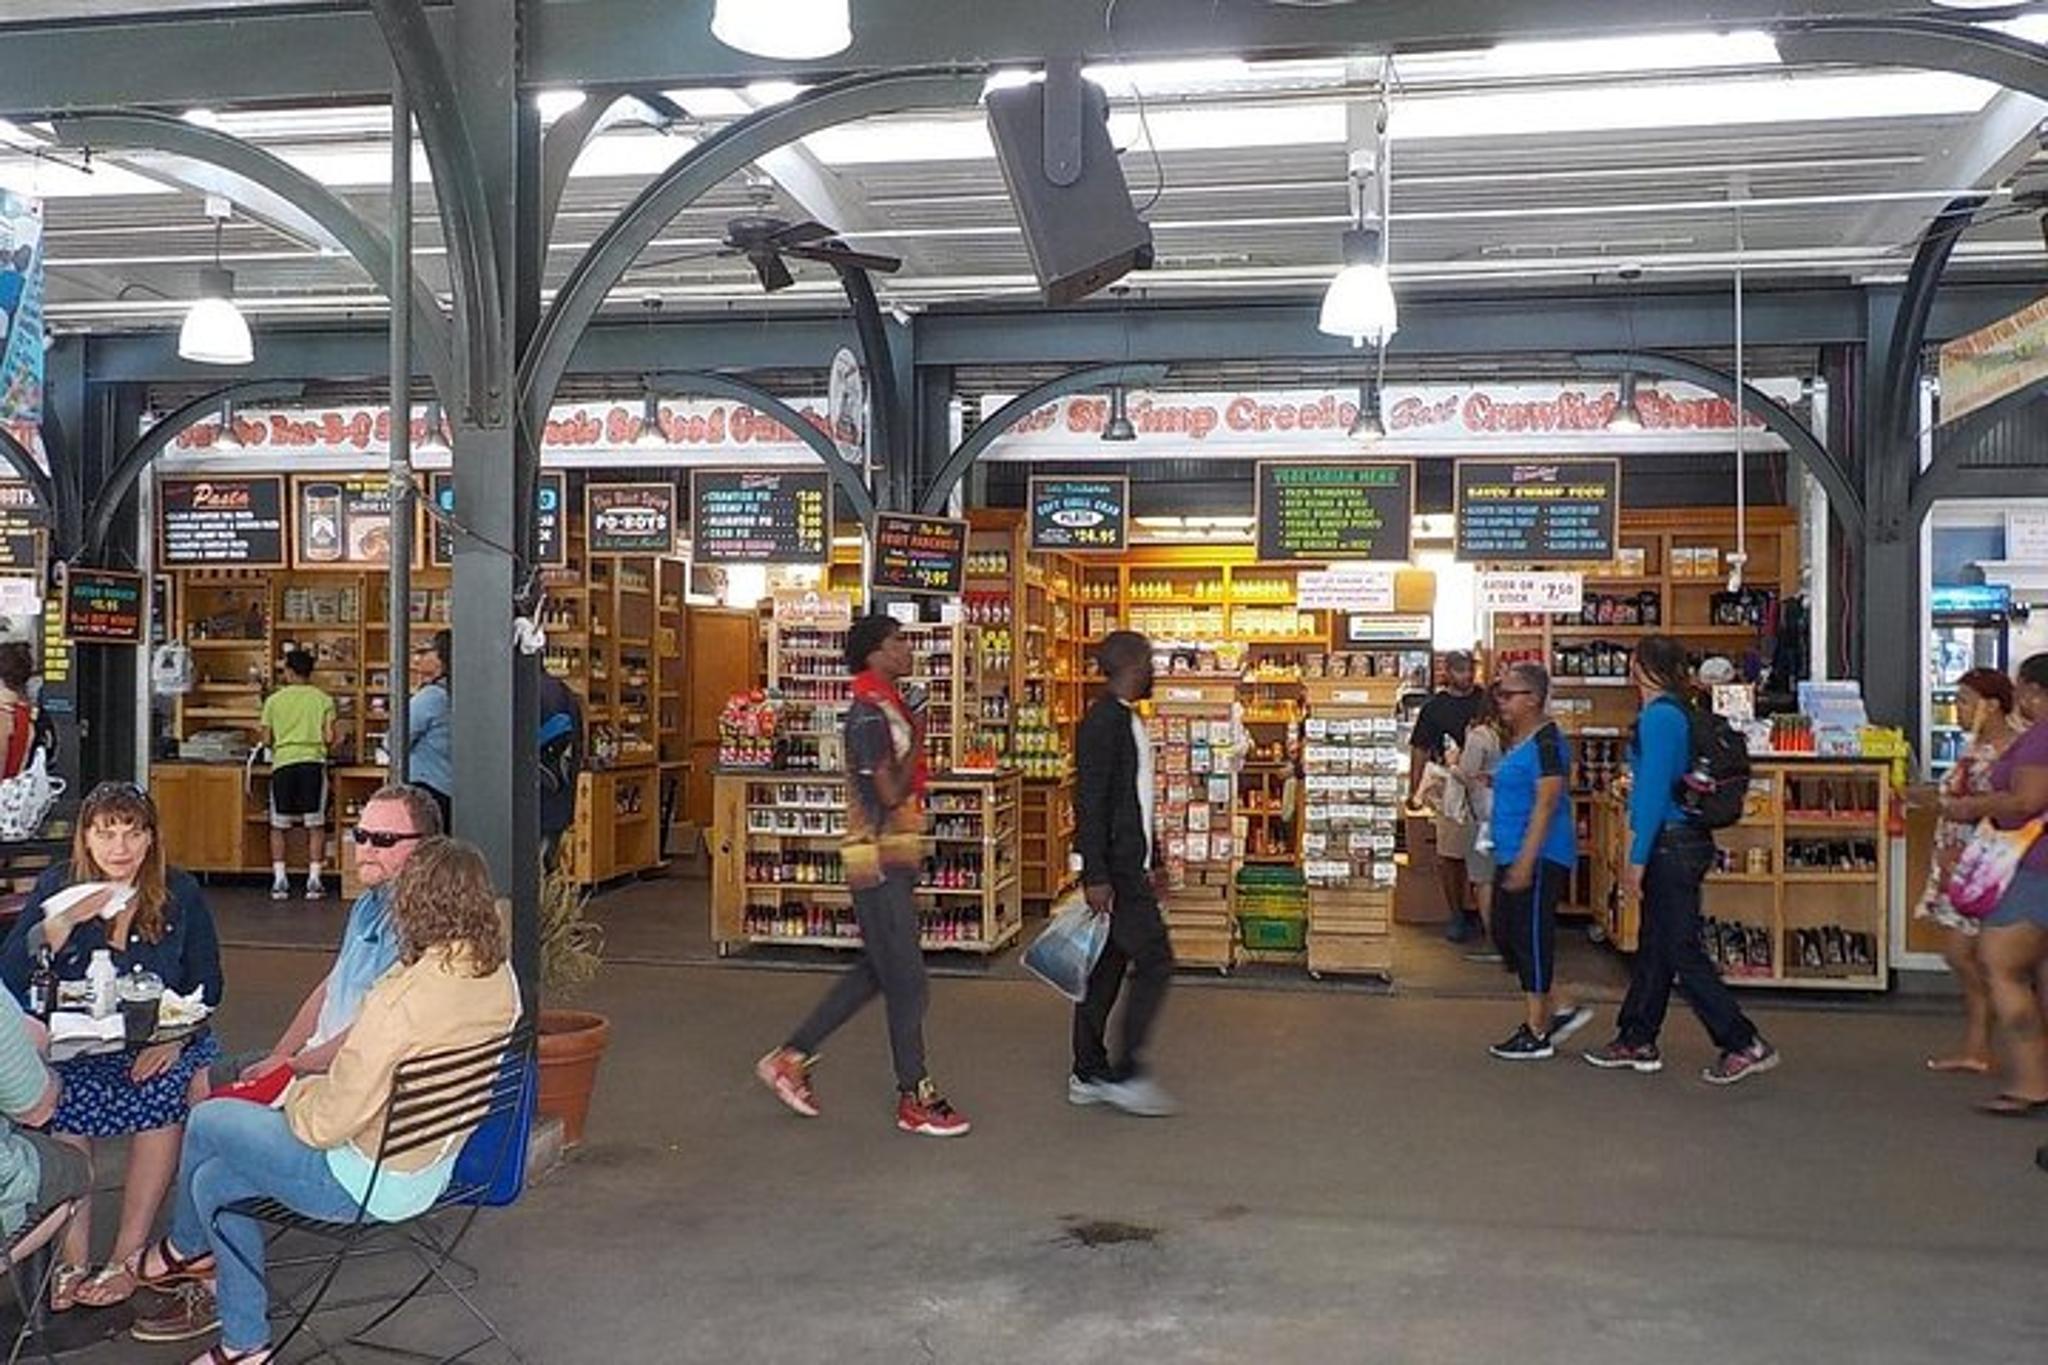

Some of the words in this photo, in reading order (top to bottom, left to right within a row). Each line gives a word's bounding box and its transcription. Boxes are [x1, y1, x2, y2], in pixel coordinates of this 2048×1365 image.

[607, 407, 726, 445] Sefood
[192, 483, 250, 509] Pasta
[596, 514, 667, 530] PO-BOYS
